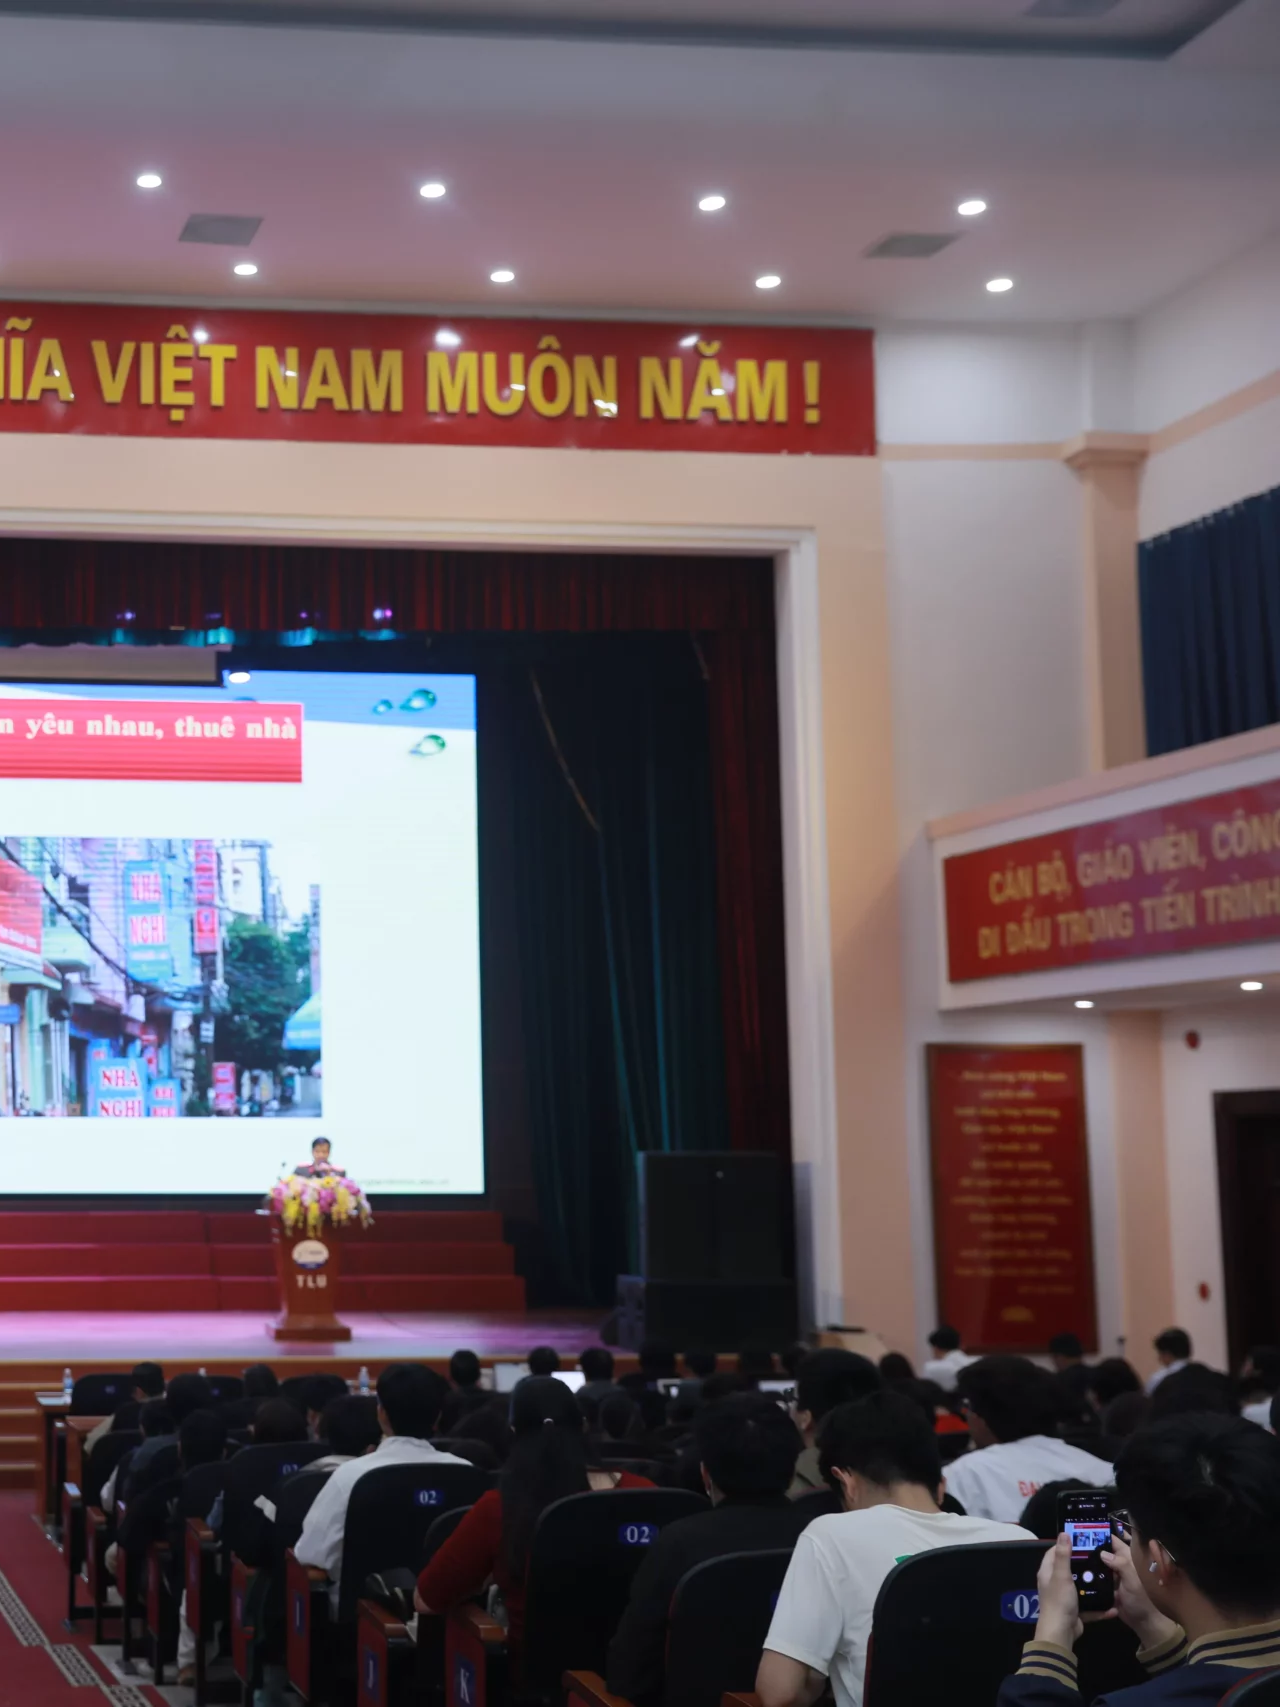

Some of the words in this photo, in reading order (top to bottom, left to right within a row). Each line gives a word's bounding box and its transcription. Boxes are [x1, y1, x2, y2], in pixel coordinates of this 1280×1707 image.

[91, 324, 238, 421] VIỆT
[255, 346, 403, 412] NAM
[426, 336, 618, 418] MUÔN
[26, 712, 74, 739] yêu
[87, 714, 164, 740] nhau,
[175, 716, 236, 739] thuê
[246, 716, 297, 740] nhà
[1057, 902, 1134, 947] TRONG
[418, 1490, 437, 1505] 02
[626, 1526, 651, 1543] 02
